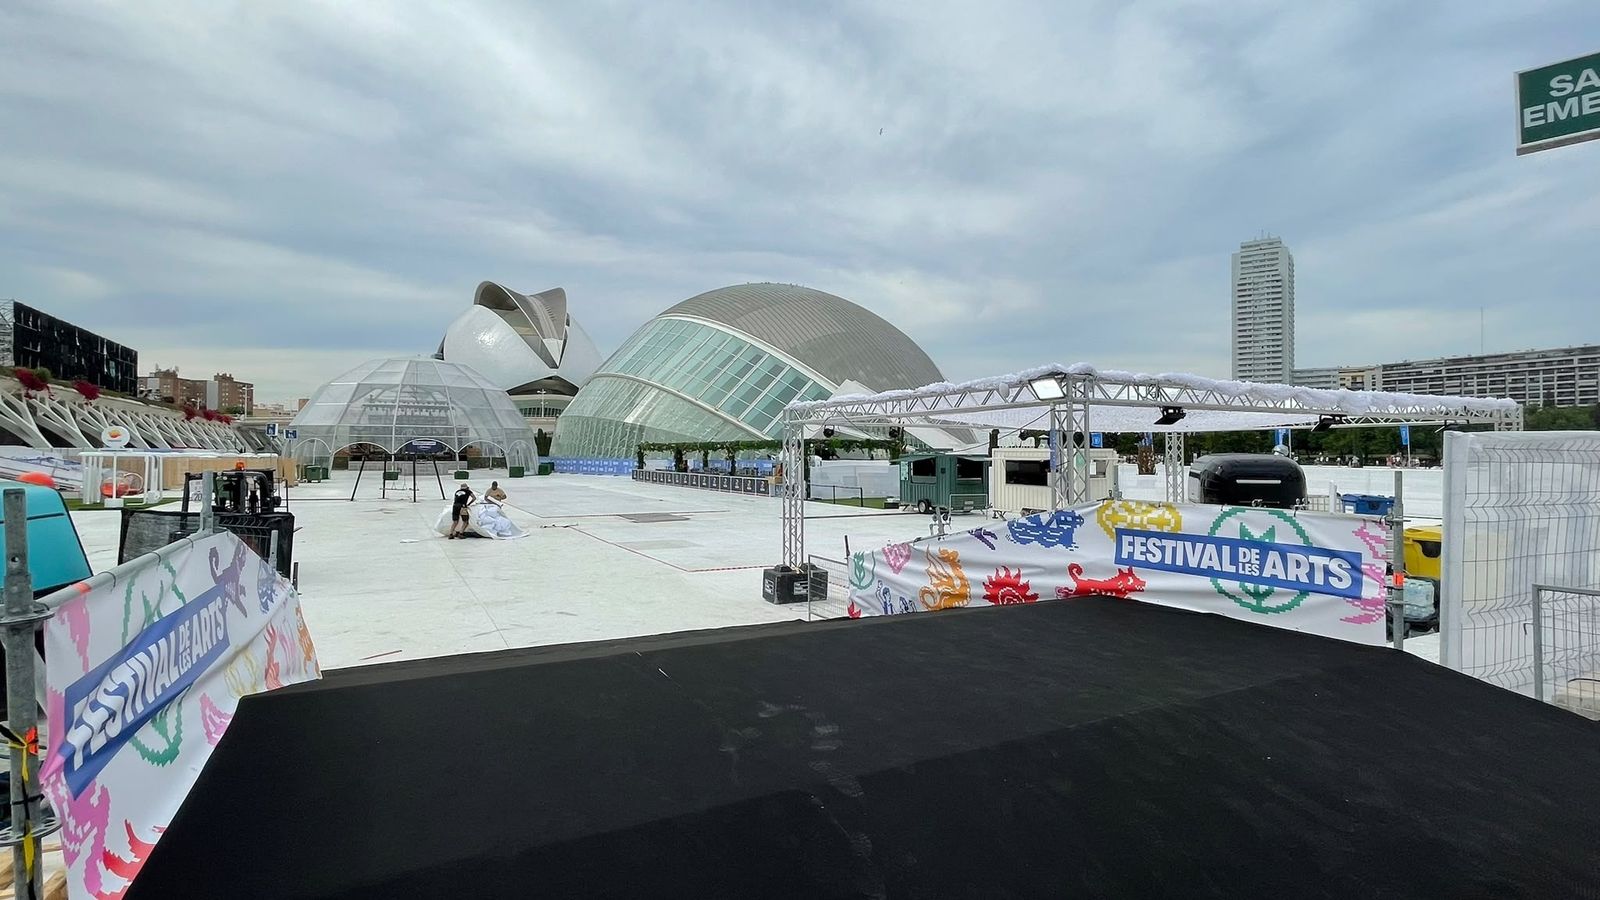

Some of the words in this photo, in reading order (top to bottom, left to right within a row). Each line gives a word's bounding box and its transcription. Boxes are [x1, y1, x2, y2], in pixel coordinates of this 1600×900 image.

[1121, 534, 1236, 573] FESTIVAL
[1239, 547, 1260, 565] DE
[1239, 562, 1260, 577] LES
[1262, 551, 1352, 590] ARTS
[179, 620, 191, 654] DE
[192, 596, 224, 665] ARTS
[179, 647, 192, 676] LES
[66, 630, 180, 771] FESTIVAL
